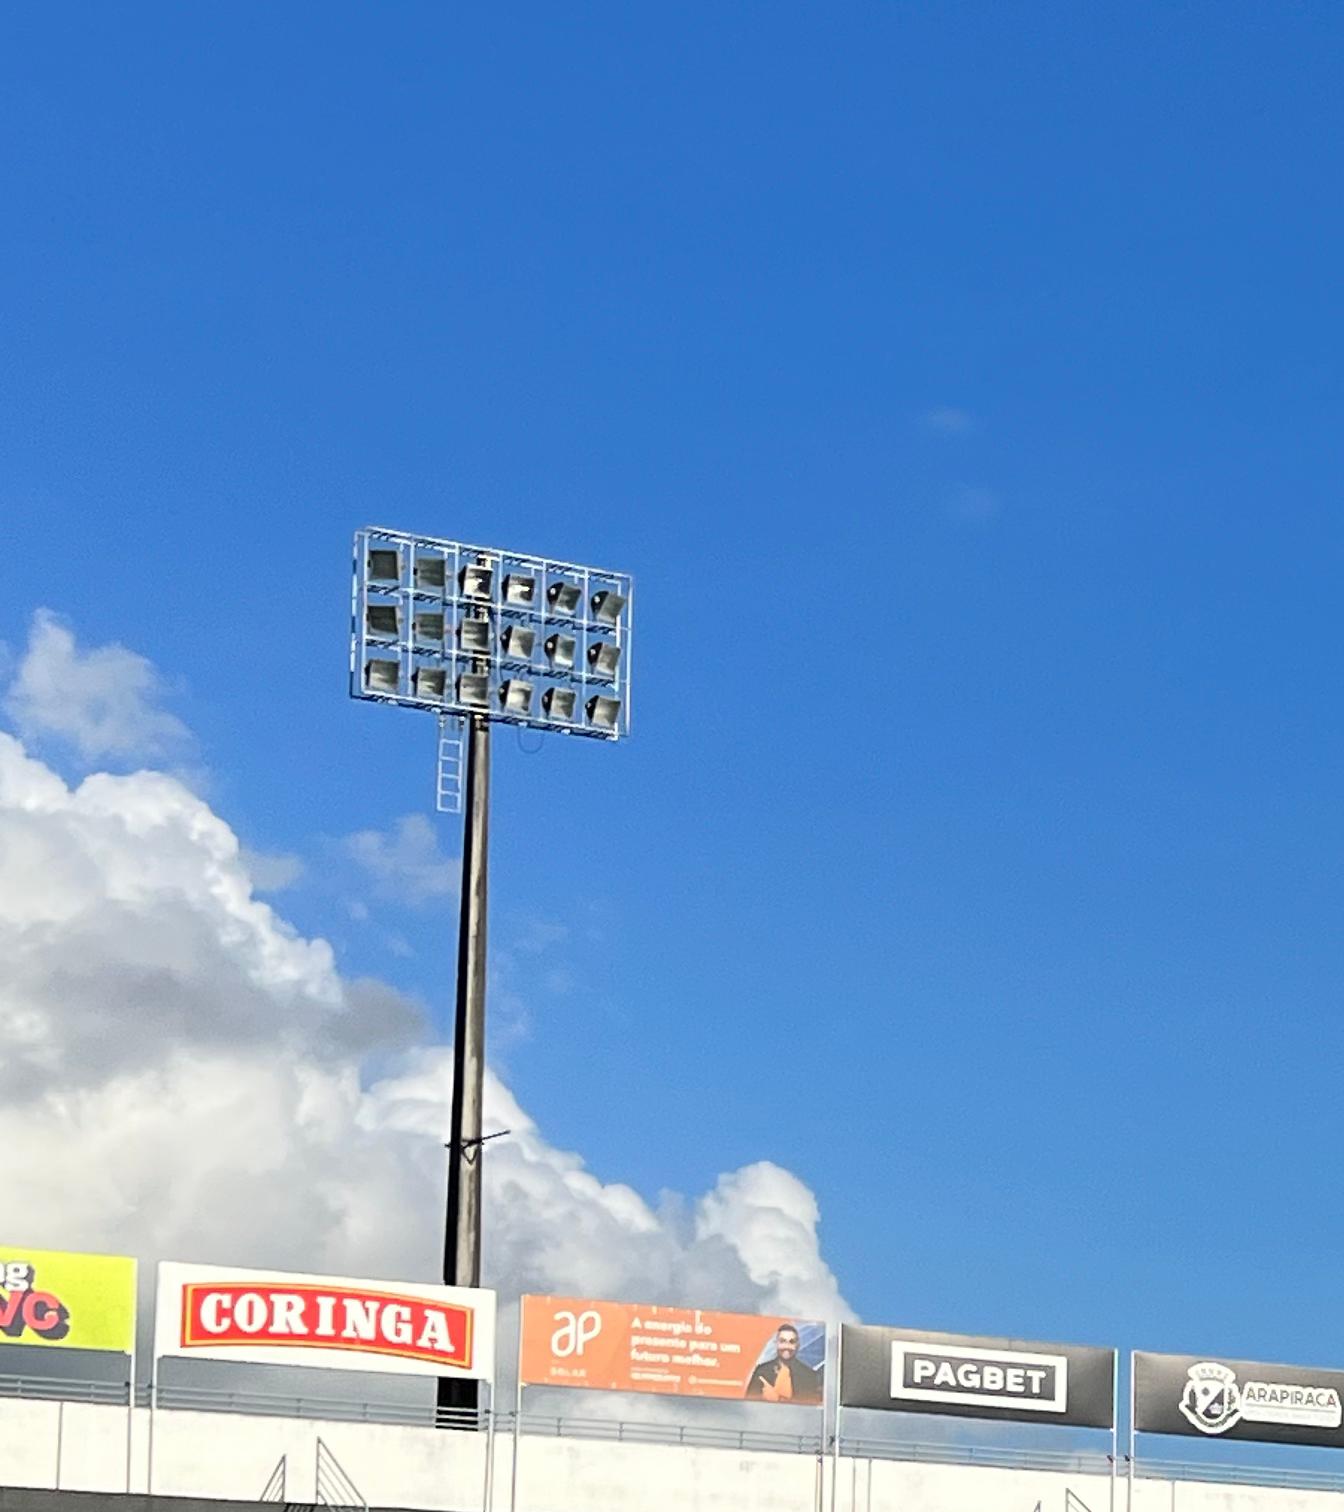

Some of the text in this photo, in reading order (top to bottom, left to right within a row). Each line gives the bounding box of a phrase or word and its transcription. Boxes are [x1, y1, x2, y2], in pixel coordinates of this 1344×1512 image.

[199, 1292, 456, 1353] CORINGA
[631, 1317, 642, 1329] A
[631, 1335, 687, 1349] presente
[689, 1340, 717, 1352] para
[630, 1348, 670, 1363] futuro
[913, 1359, 1046, 1394] PAGBET
[1246, 1386, 1337, 1408] ARAPIRACA
